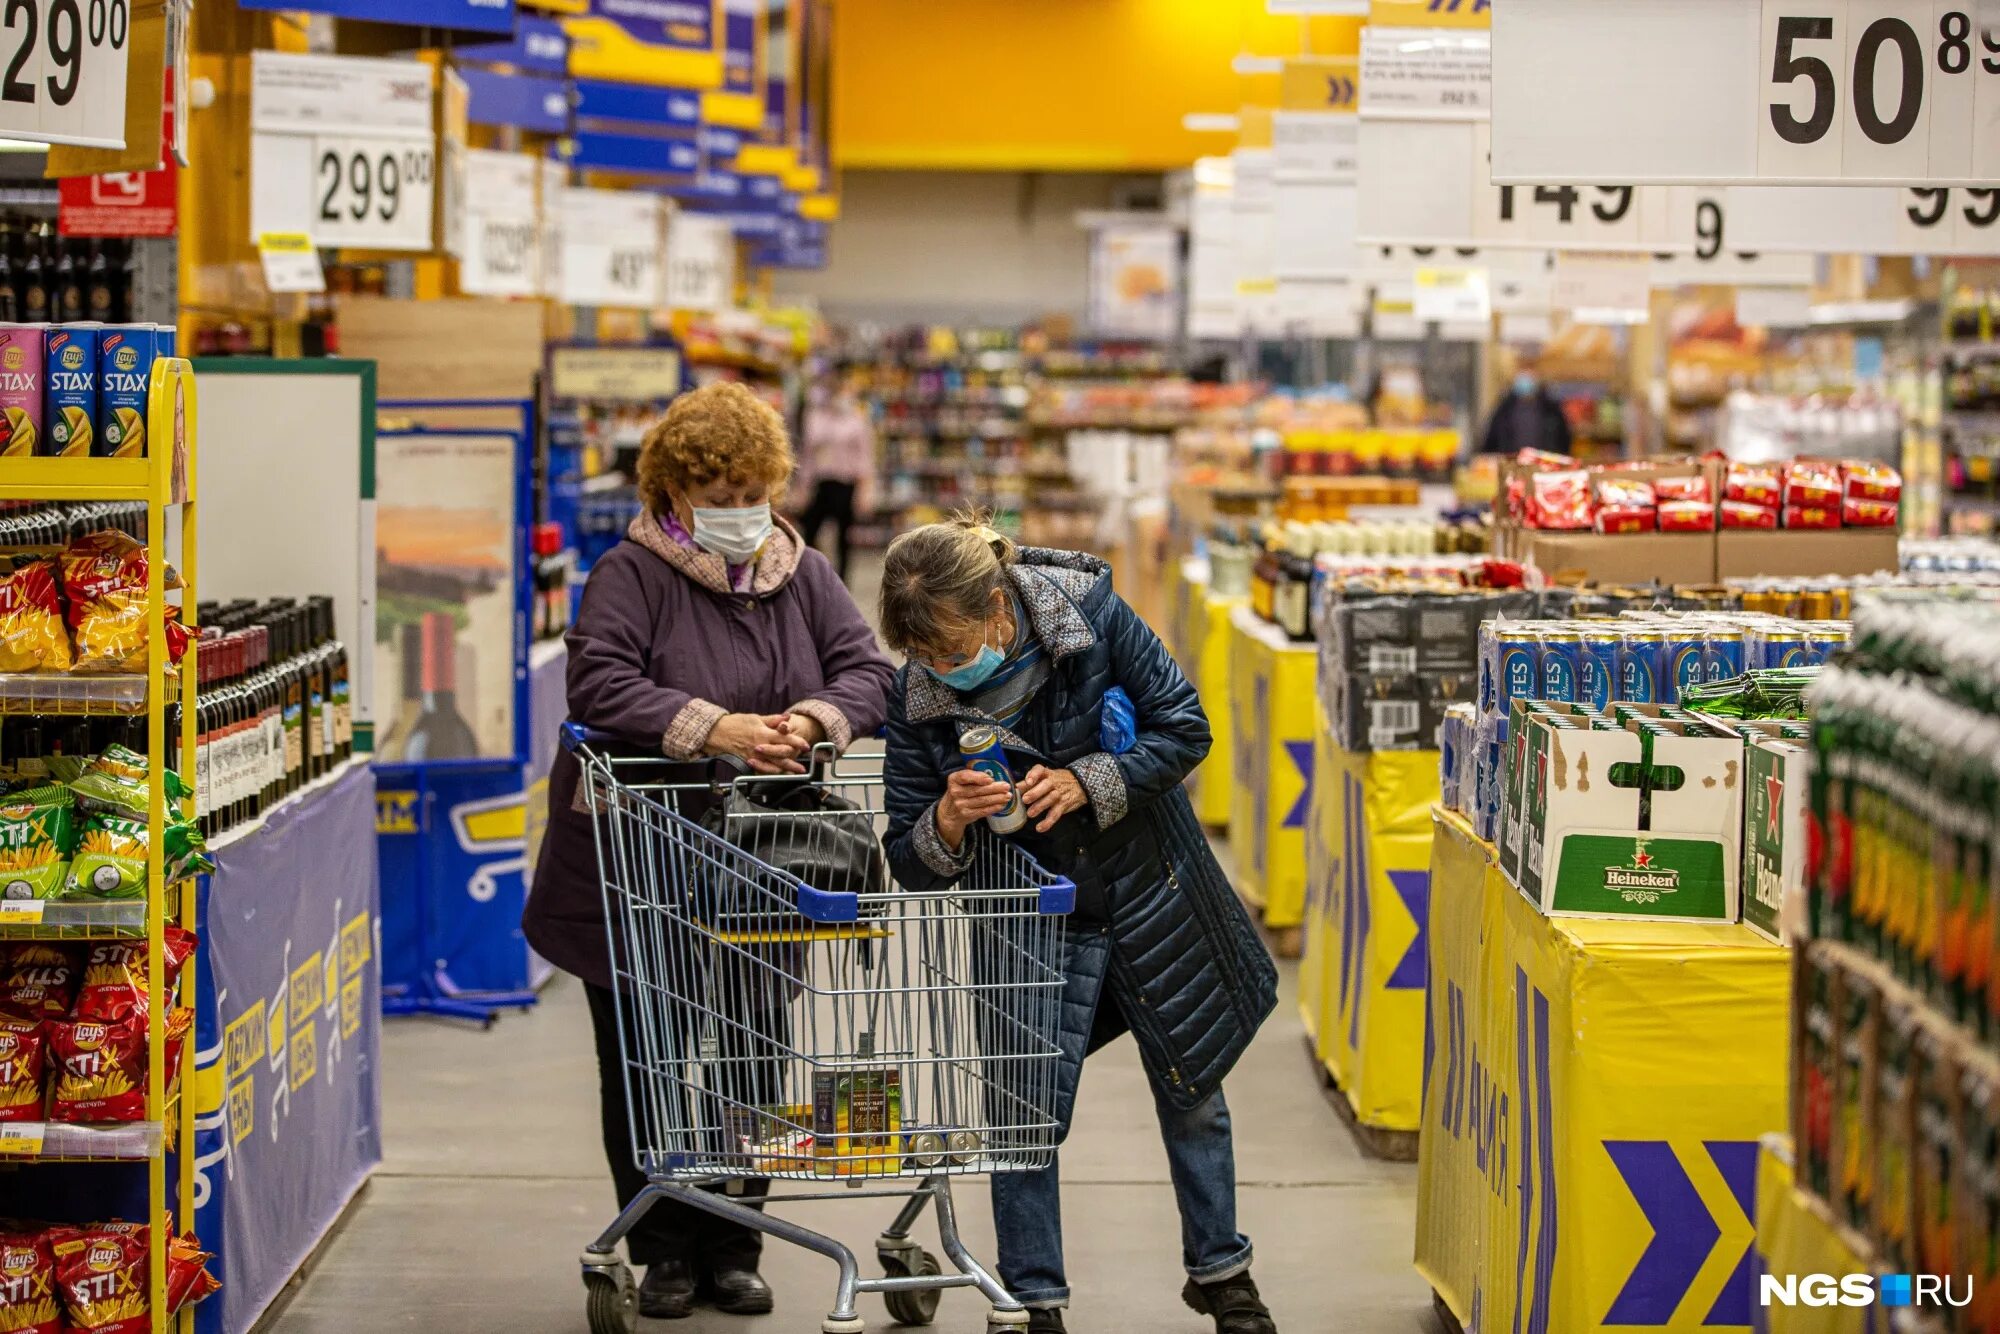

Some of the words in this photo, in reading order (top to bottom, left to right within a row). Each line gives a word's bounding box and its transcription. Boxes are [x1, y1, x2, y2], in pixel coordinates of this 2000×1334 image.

[2, 0, 82, 106] 29
[1770, 16, 1924, 145] 50
[320, 150, 399, 222] 299
[52, 372, 93, 390] STAX
[105, 373, 146, 391] STAX
[1511, 662, 1528, 700] FES
[1606, 870, 1674, 888] Heineken
[65, 1043, 120, 1077] STIX
[76, 1266, 137, 1300] STIX
